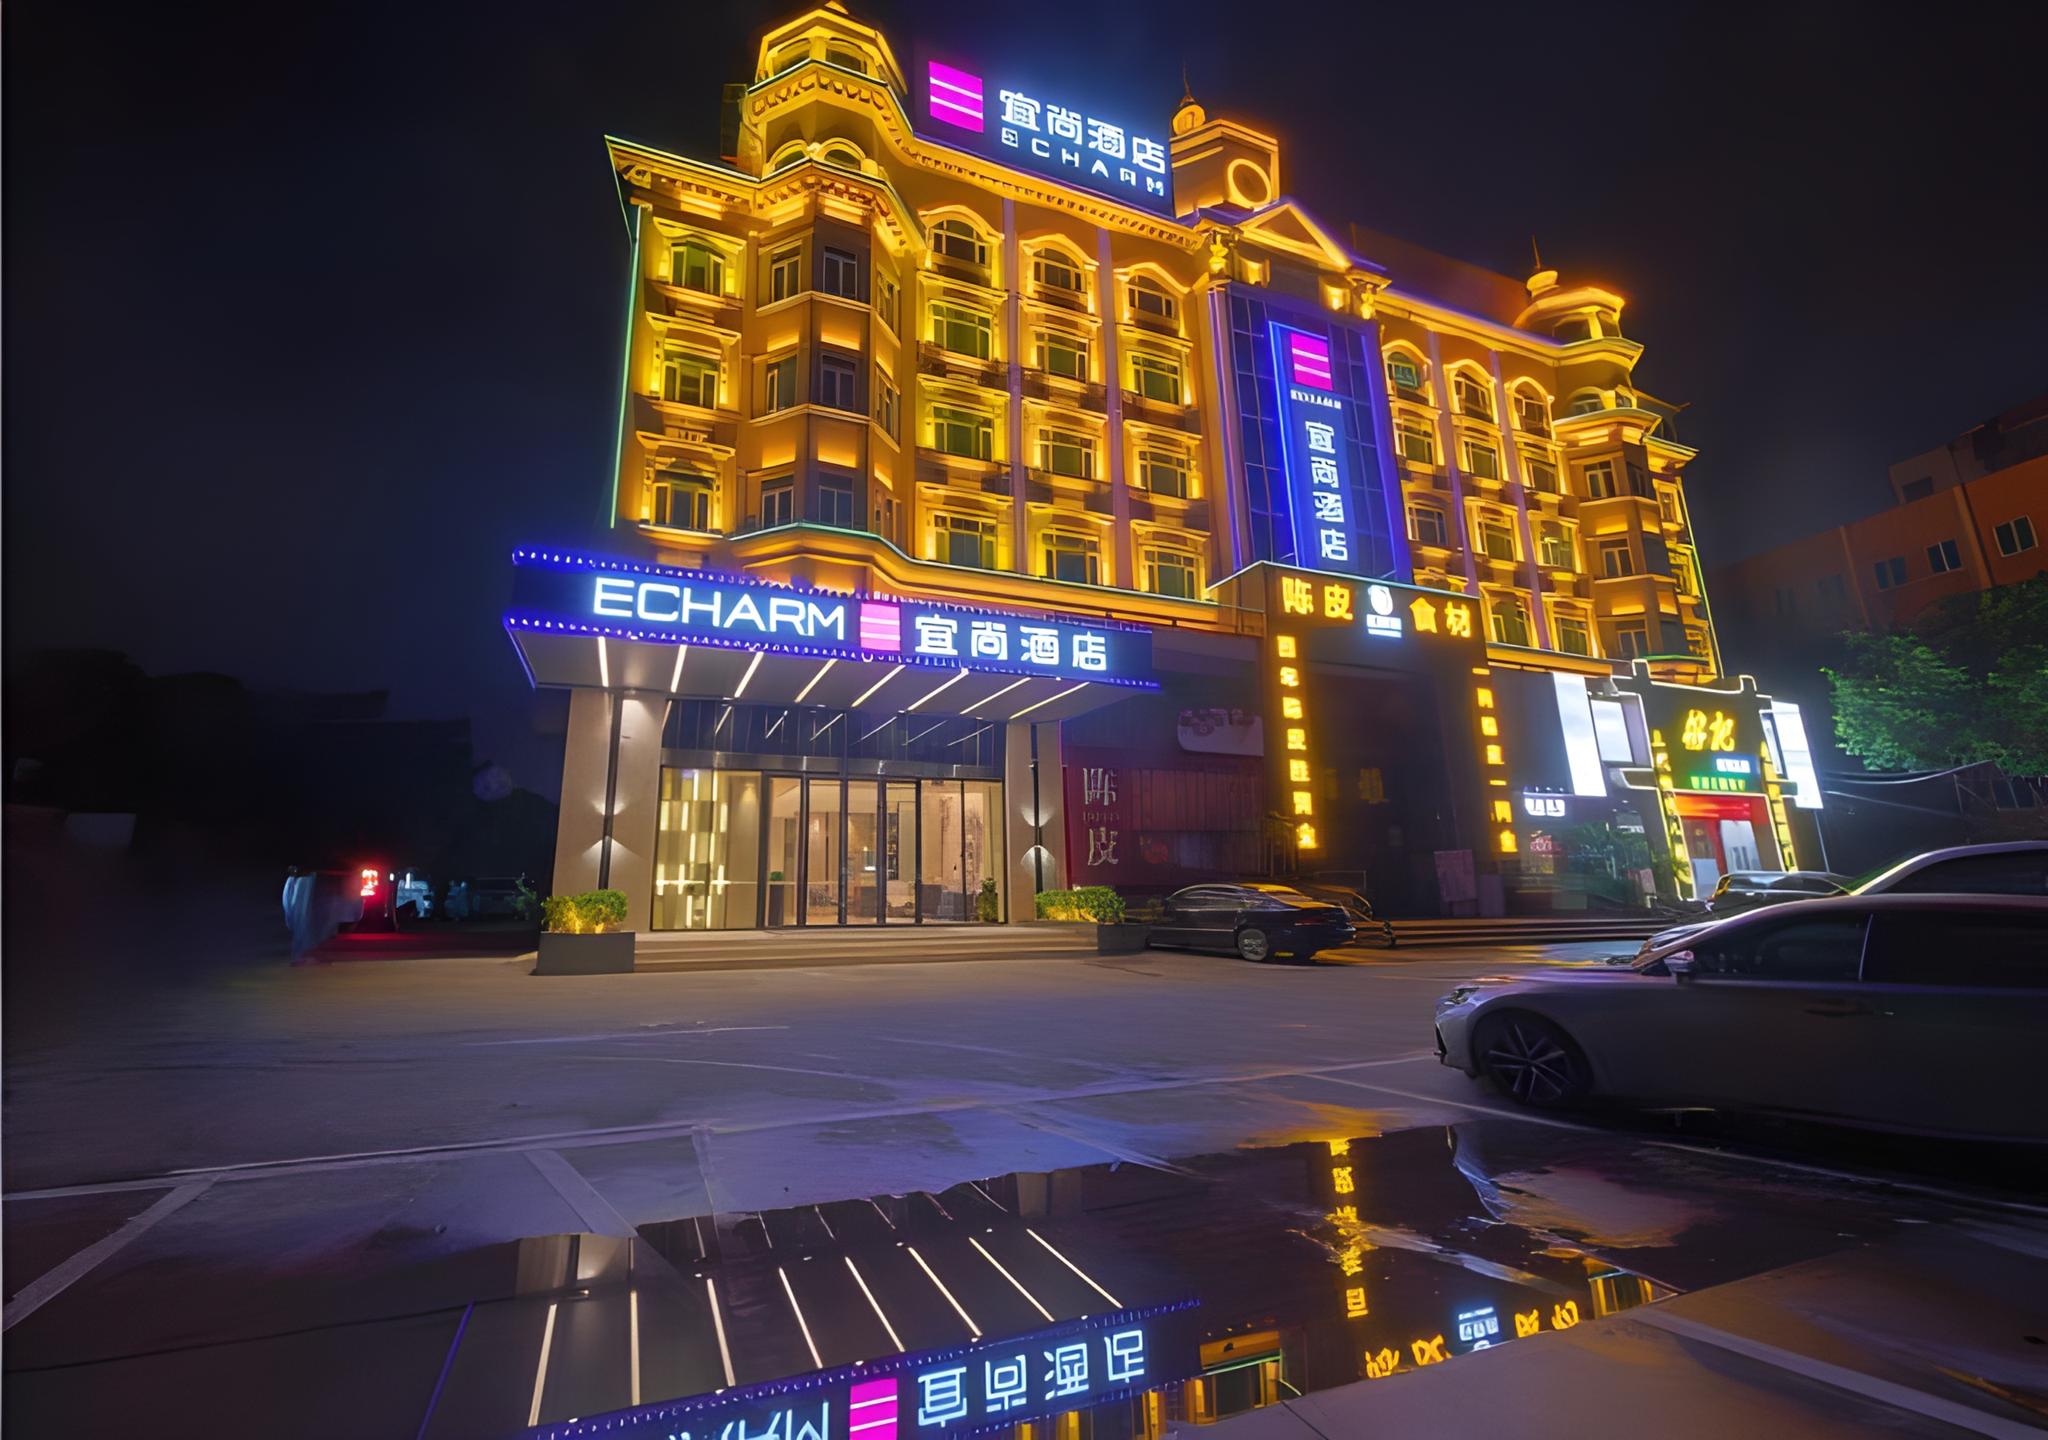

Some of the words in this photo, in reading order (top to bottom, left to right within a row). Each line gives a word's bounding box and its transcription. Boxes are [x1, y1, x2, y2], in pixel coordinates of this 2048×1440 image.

[1000, 89, 1166, 174] 宜尚酒店
[593, 577, 845, 640] ECHARM
[914, 613, 1107, 671] 宜尚酒店
